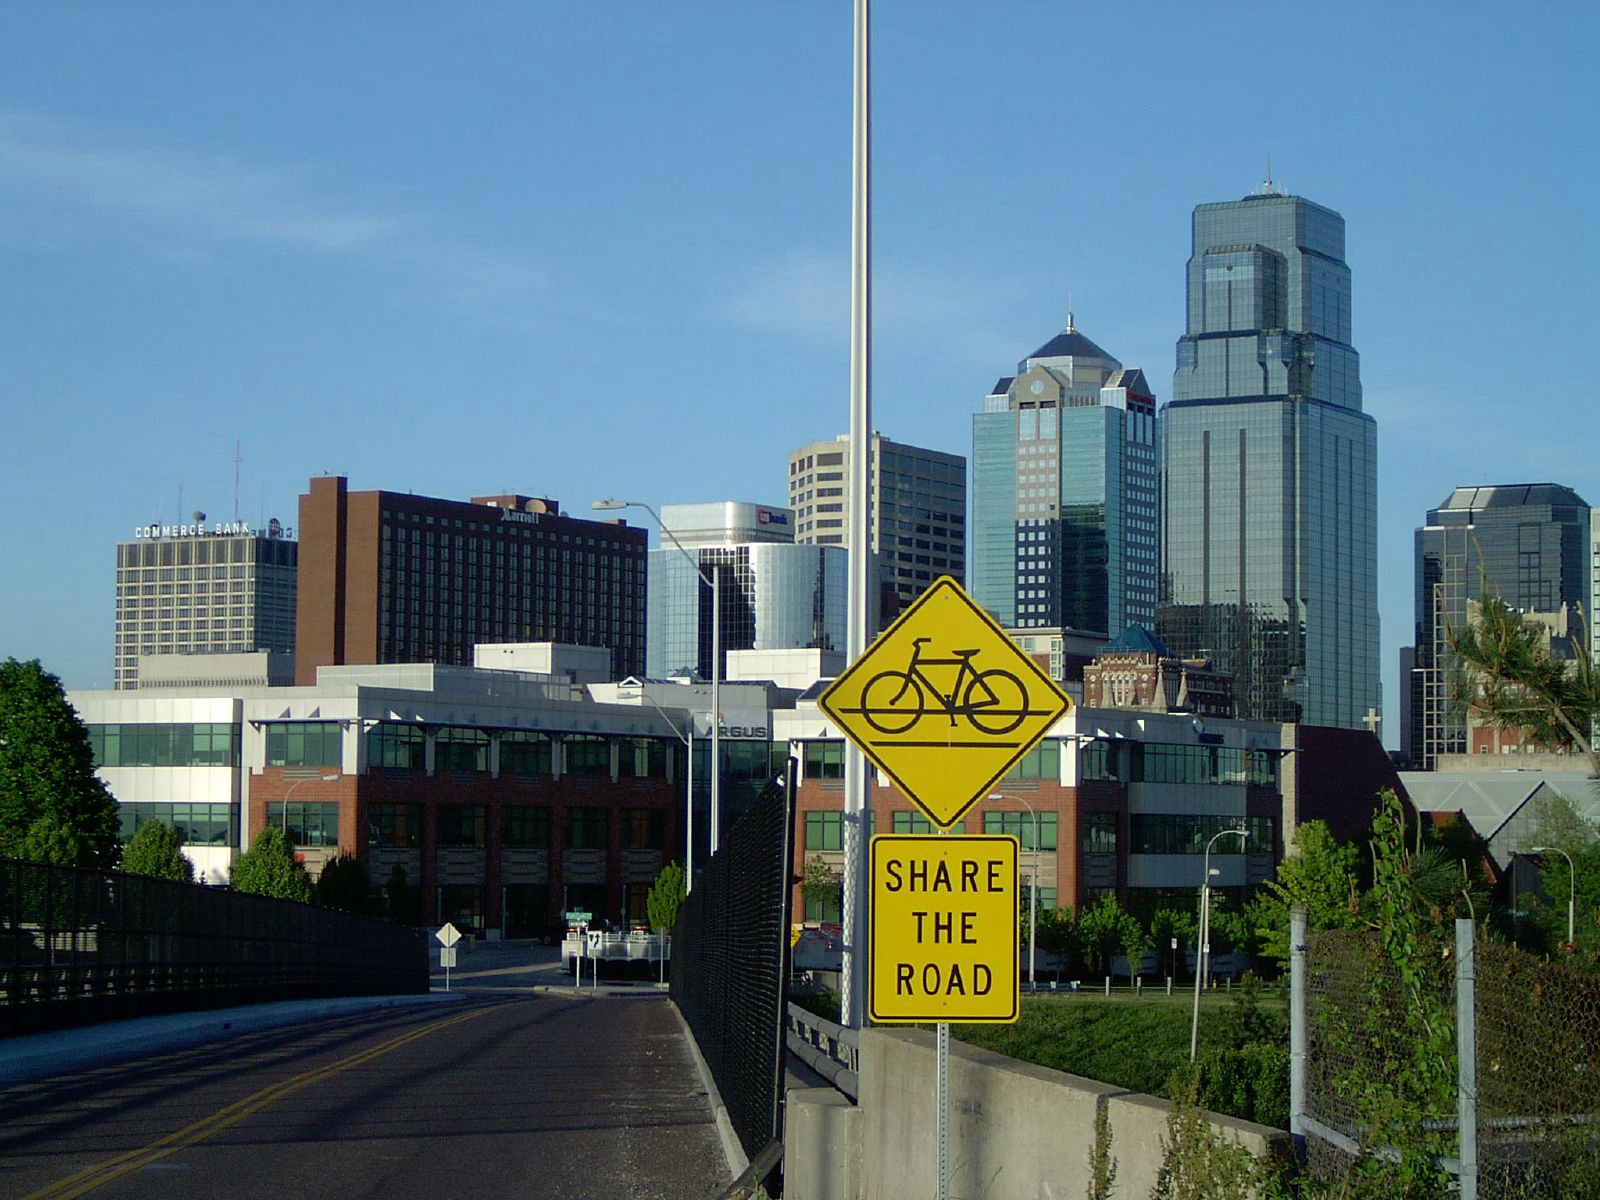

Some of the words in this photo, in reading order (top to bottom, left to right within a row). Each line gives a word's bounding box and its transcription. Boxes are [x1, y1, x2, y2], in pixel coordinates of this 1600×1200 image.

[135, 523, 204, 538] COMMERCE
[215, 521, 250, 535] BANK
[501, 508, 539, 525] Marriott
[885, 859, 1004, 892] SHARE
[912, 912, 977, 944] THE
[897, 963, 992, 996] ROAD
